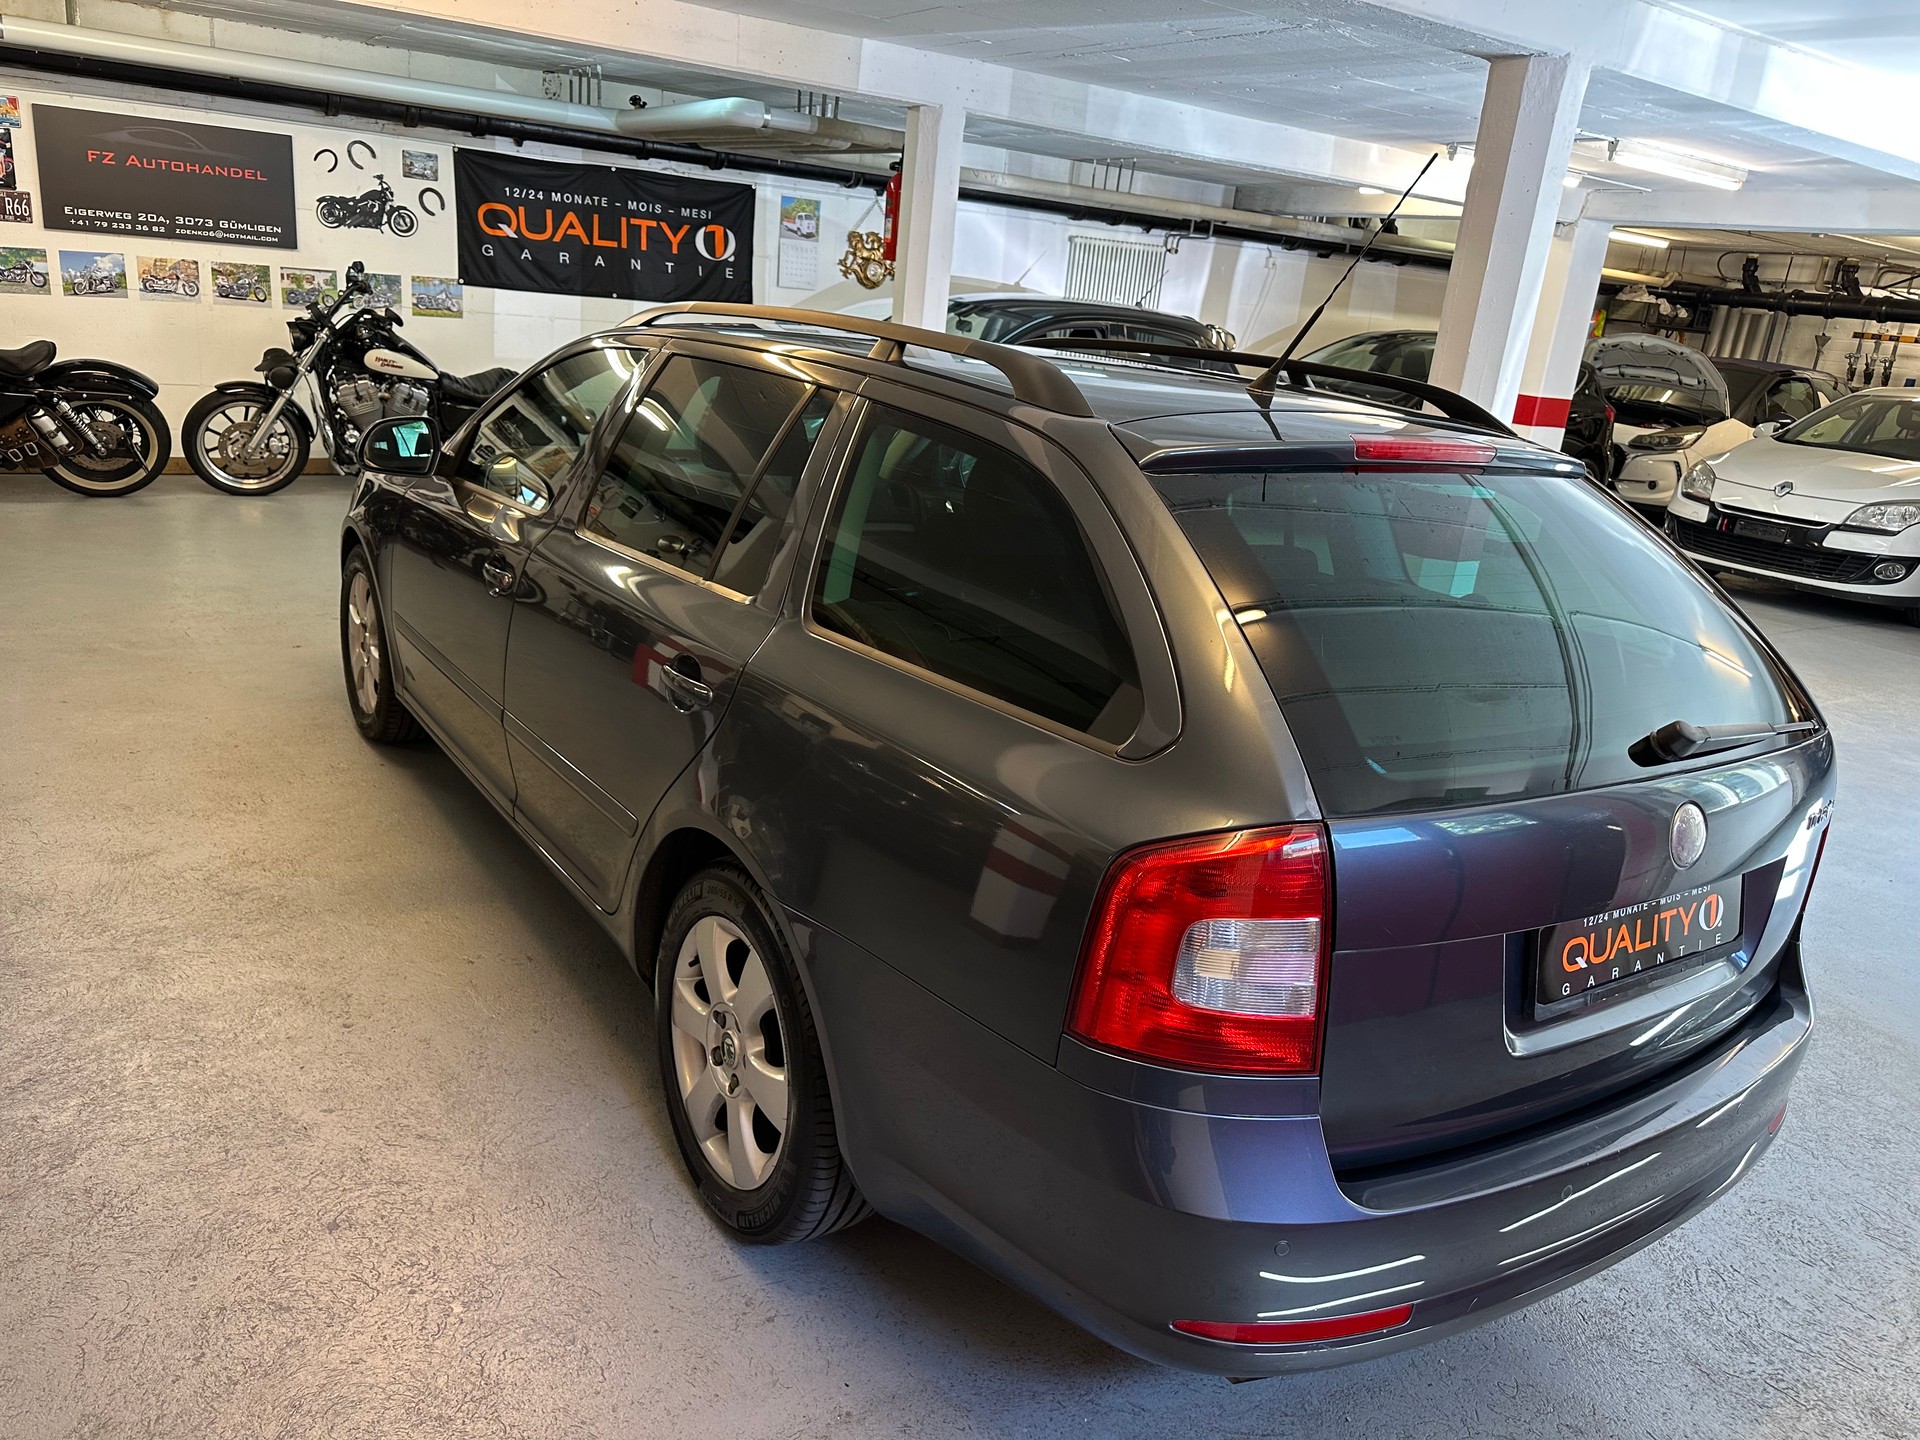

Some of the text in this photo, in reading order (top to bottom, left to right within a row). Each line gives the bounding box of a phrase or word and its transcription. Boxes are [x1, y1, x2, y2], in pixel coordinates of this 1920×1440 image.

[87, 150, 268, 182] FZ AUTOHANDEL
[5, 197, 30, 216] R66
[504, 187, 544, 201] 12/24
[551, 192, 609, 207] MONATE
[627, 200, 662, 214] MOIS
[681, 207, 712, 220] MESI
[64, 206, 282, 234] EIGERWEG 20A, 3073 GÜMLIGEN
[70, 218, 89, 226] +41
[112, 222, 132, 230] 233
[477, 202, 691, 254] QUALITY
[482, 244, 735, 280] GARANTIE
[1583, 914, 1609, 928] 12/24
[1562, 902, 1698, 973] QUALITY
[1562, 933, 1722, 996] GARANTIE
